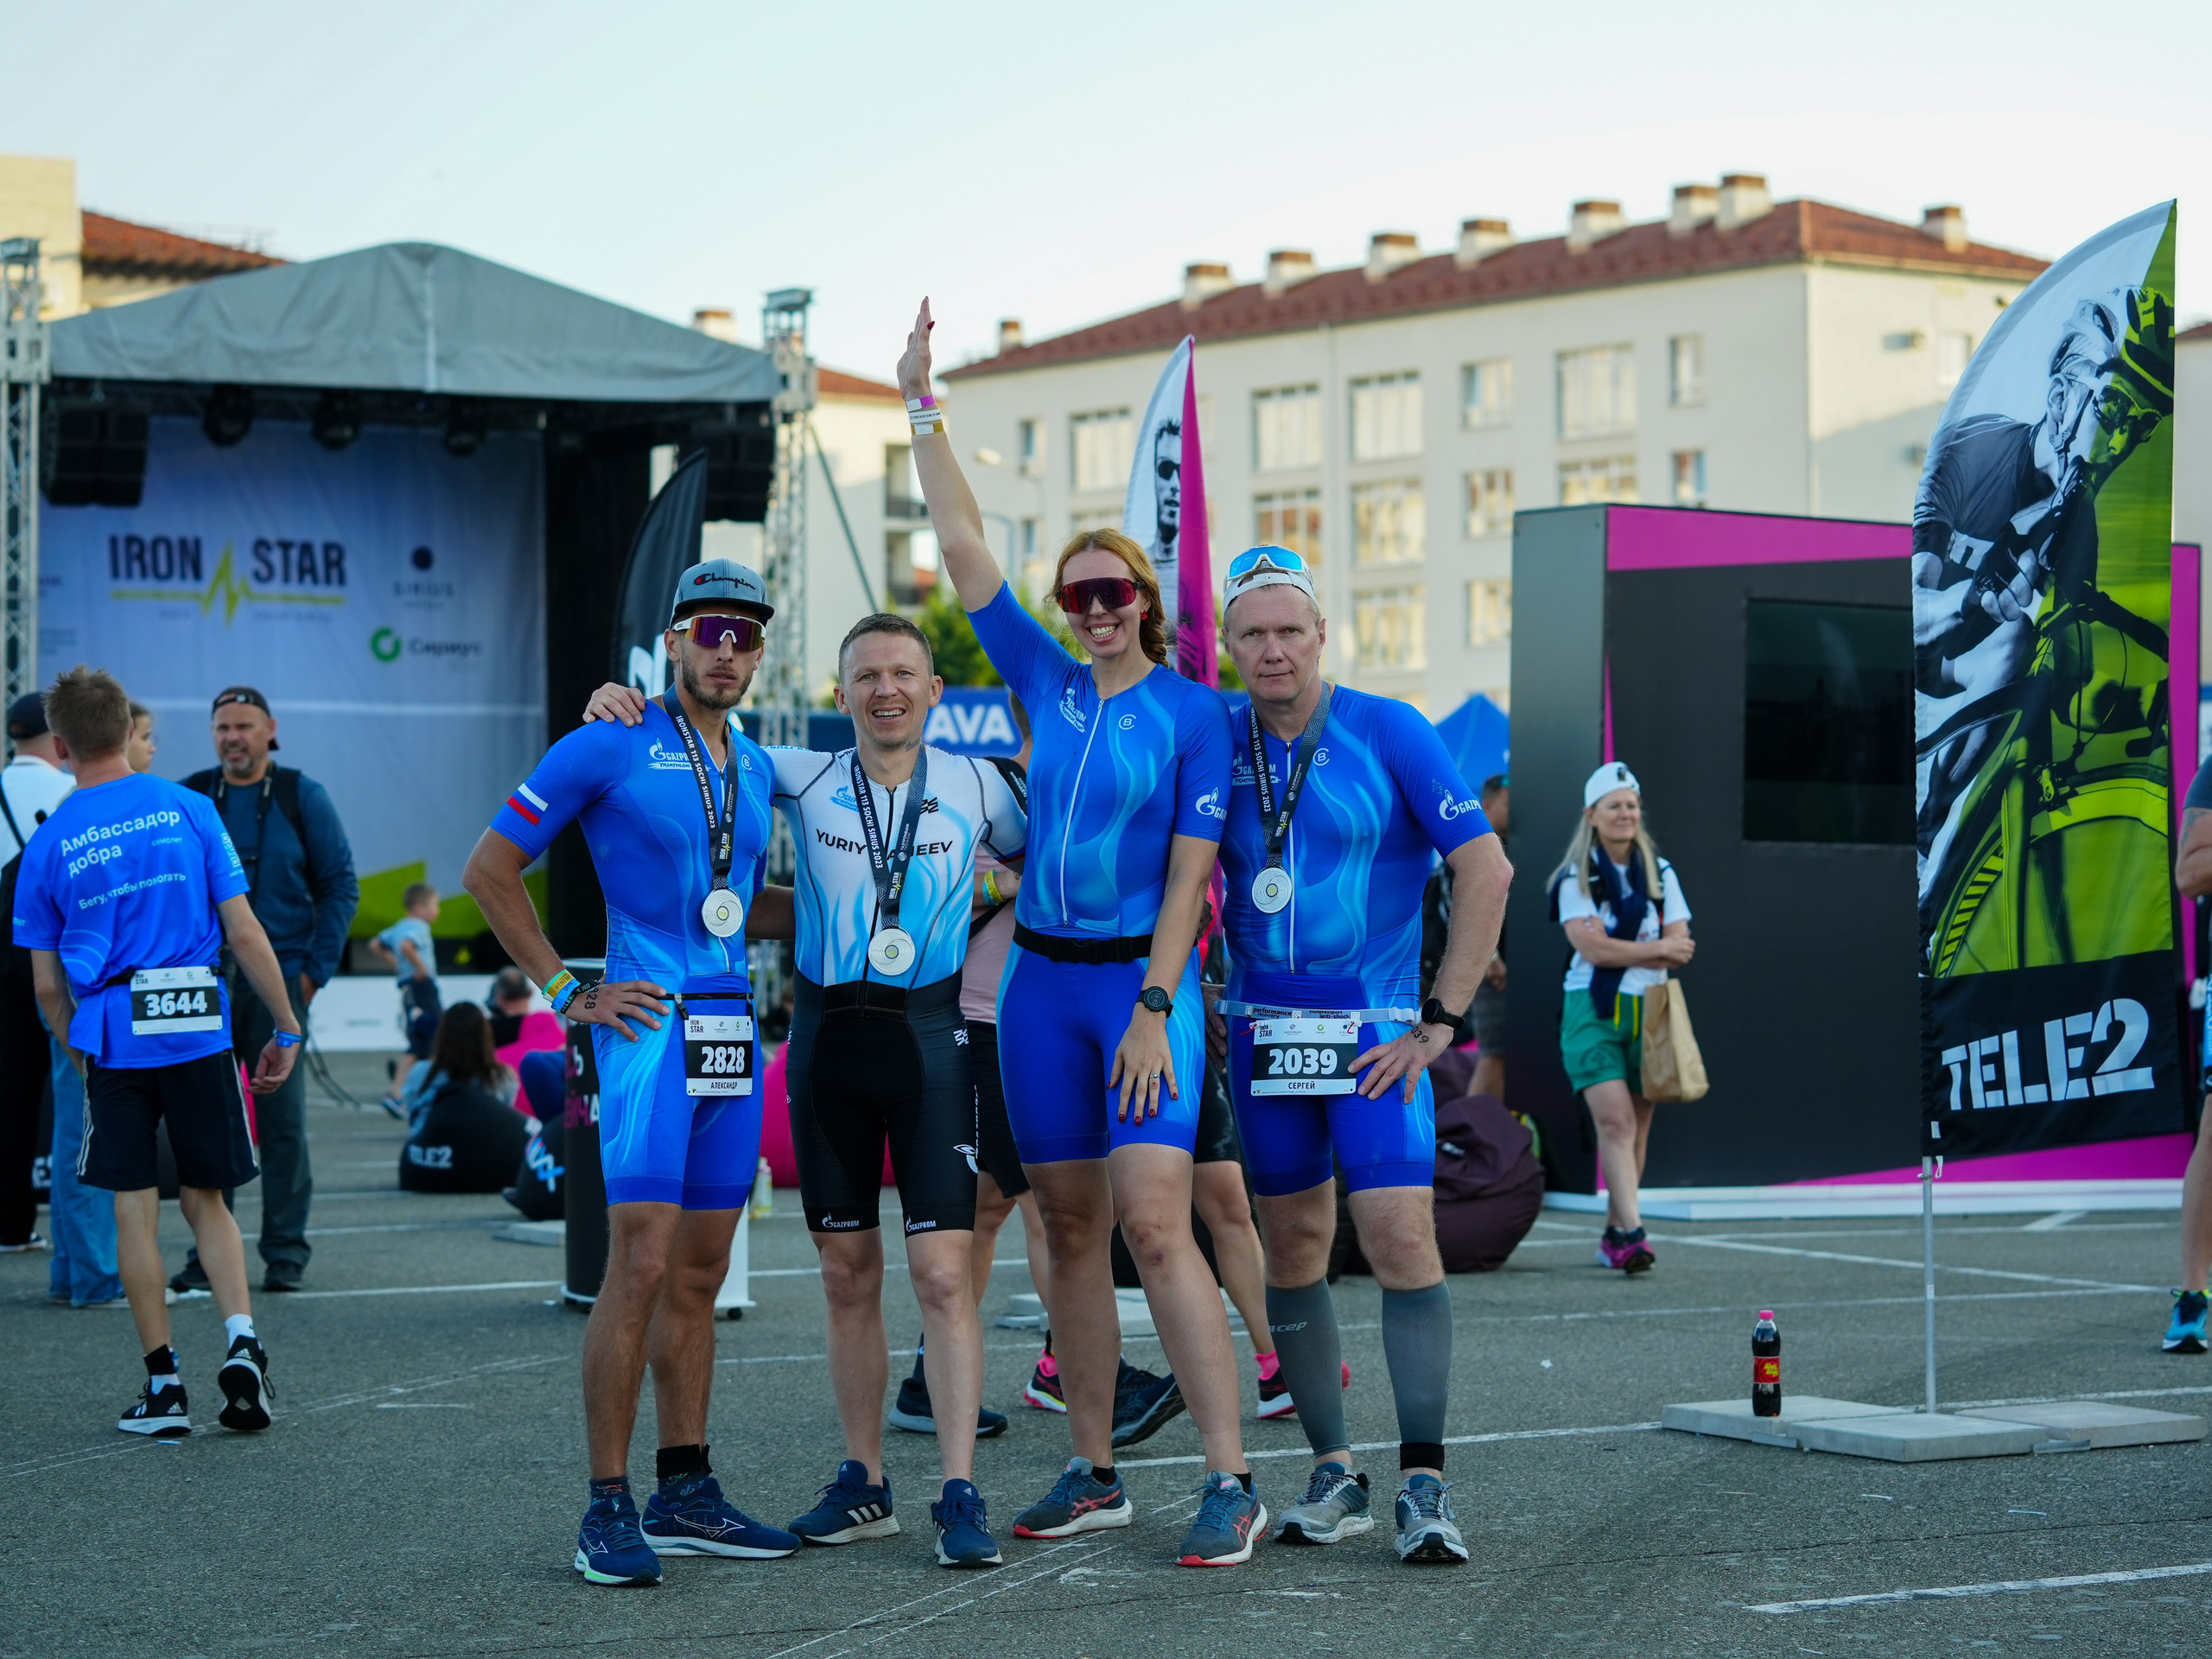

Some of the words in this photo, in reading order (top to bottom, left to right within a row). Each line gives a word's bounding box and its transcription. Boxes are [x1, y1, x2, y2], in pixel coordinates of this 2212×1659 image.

[110, 535, 202, 582] IRON
[252, 537, 346, 586] STAR
[694, 572, 756, 590] Champion
[923, 703, 1016, 745] AVA
[666, 752, 690, 761] GAZPR
[676, 715, 695, 749] IRONSTAR
[695, 763, 707, 785] SOCHI
[702, 785, 712, 809] SIRIUS
[1255, 752, 1264, 772] SOCHI
[854, 765, 864, 797] IRONSTAR
[1258, 772, 1268, 795] SIRIUS
[1262, 796, 1271, 812] 2023
[862, 807, 874, 830] SOCHI
[60, 810, 181, 857] Амбассадор
[816, 828, 868, 855] YURIY
[868, 829, 879, 850] SIRIUS
[67, 845, 123, 878] добра
[873, 852, 883, 868] 2023
[892, 872, 900, 884] STAR
[79, 893, 109, 910] Бегу,
[107, 883, 138, 898] чтобы
[139, 872, 187, 891] помогать
[144, 991, 207, 1017] 3644
[584, 988, 599, 1009] 828
[1253, 1007, 1292, 1016] performance
[1411, 1026, 1429, 1044] 039
[701, 1046, 745, 1073] 2828
[1268, 1048, 1338, 1075] 2039
[1942, 998, 2155, 1111] TELE2
[1287, 1081, 1315, 1090] СЕРГЕЙ
[912, 1220, 936, 1230] GAZPROM
